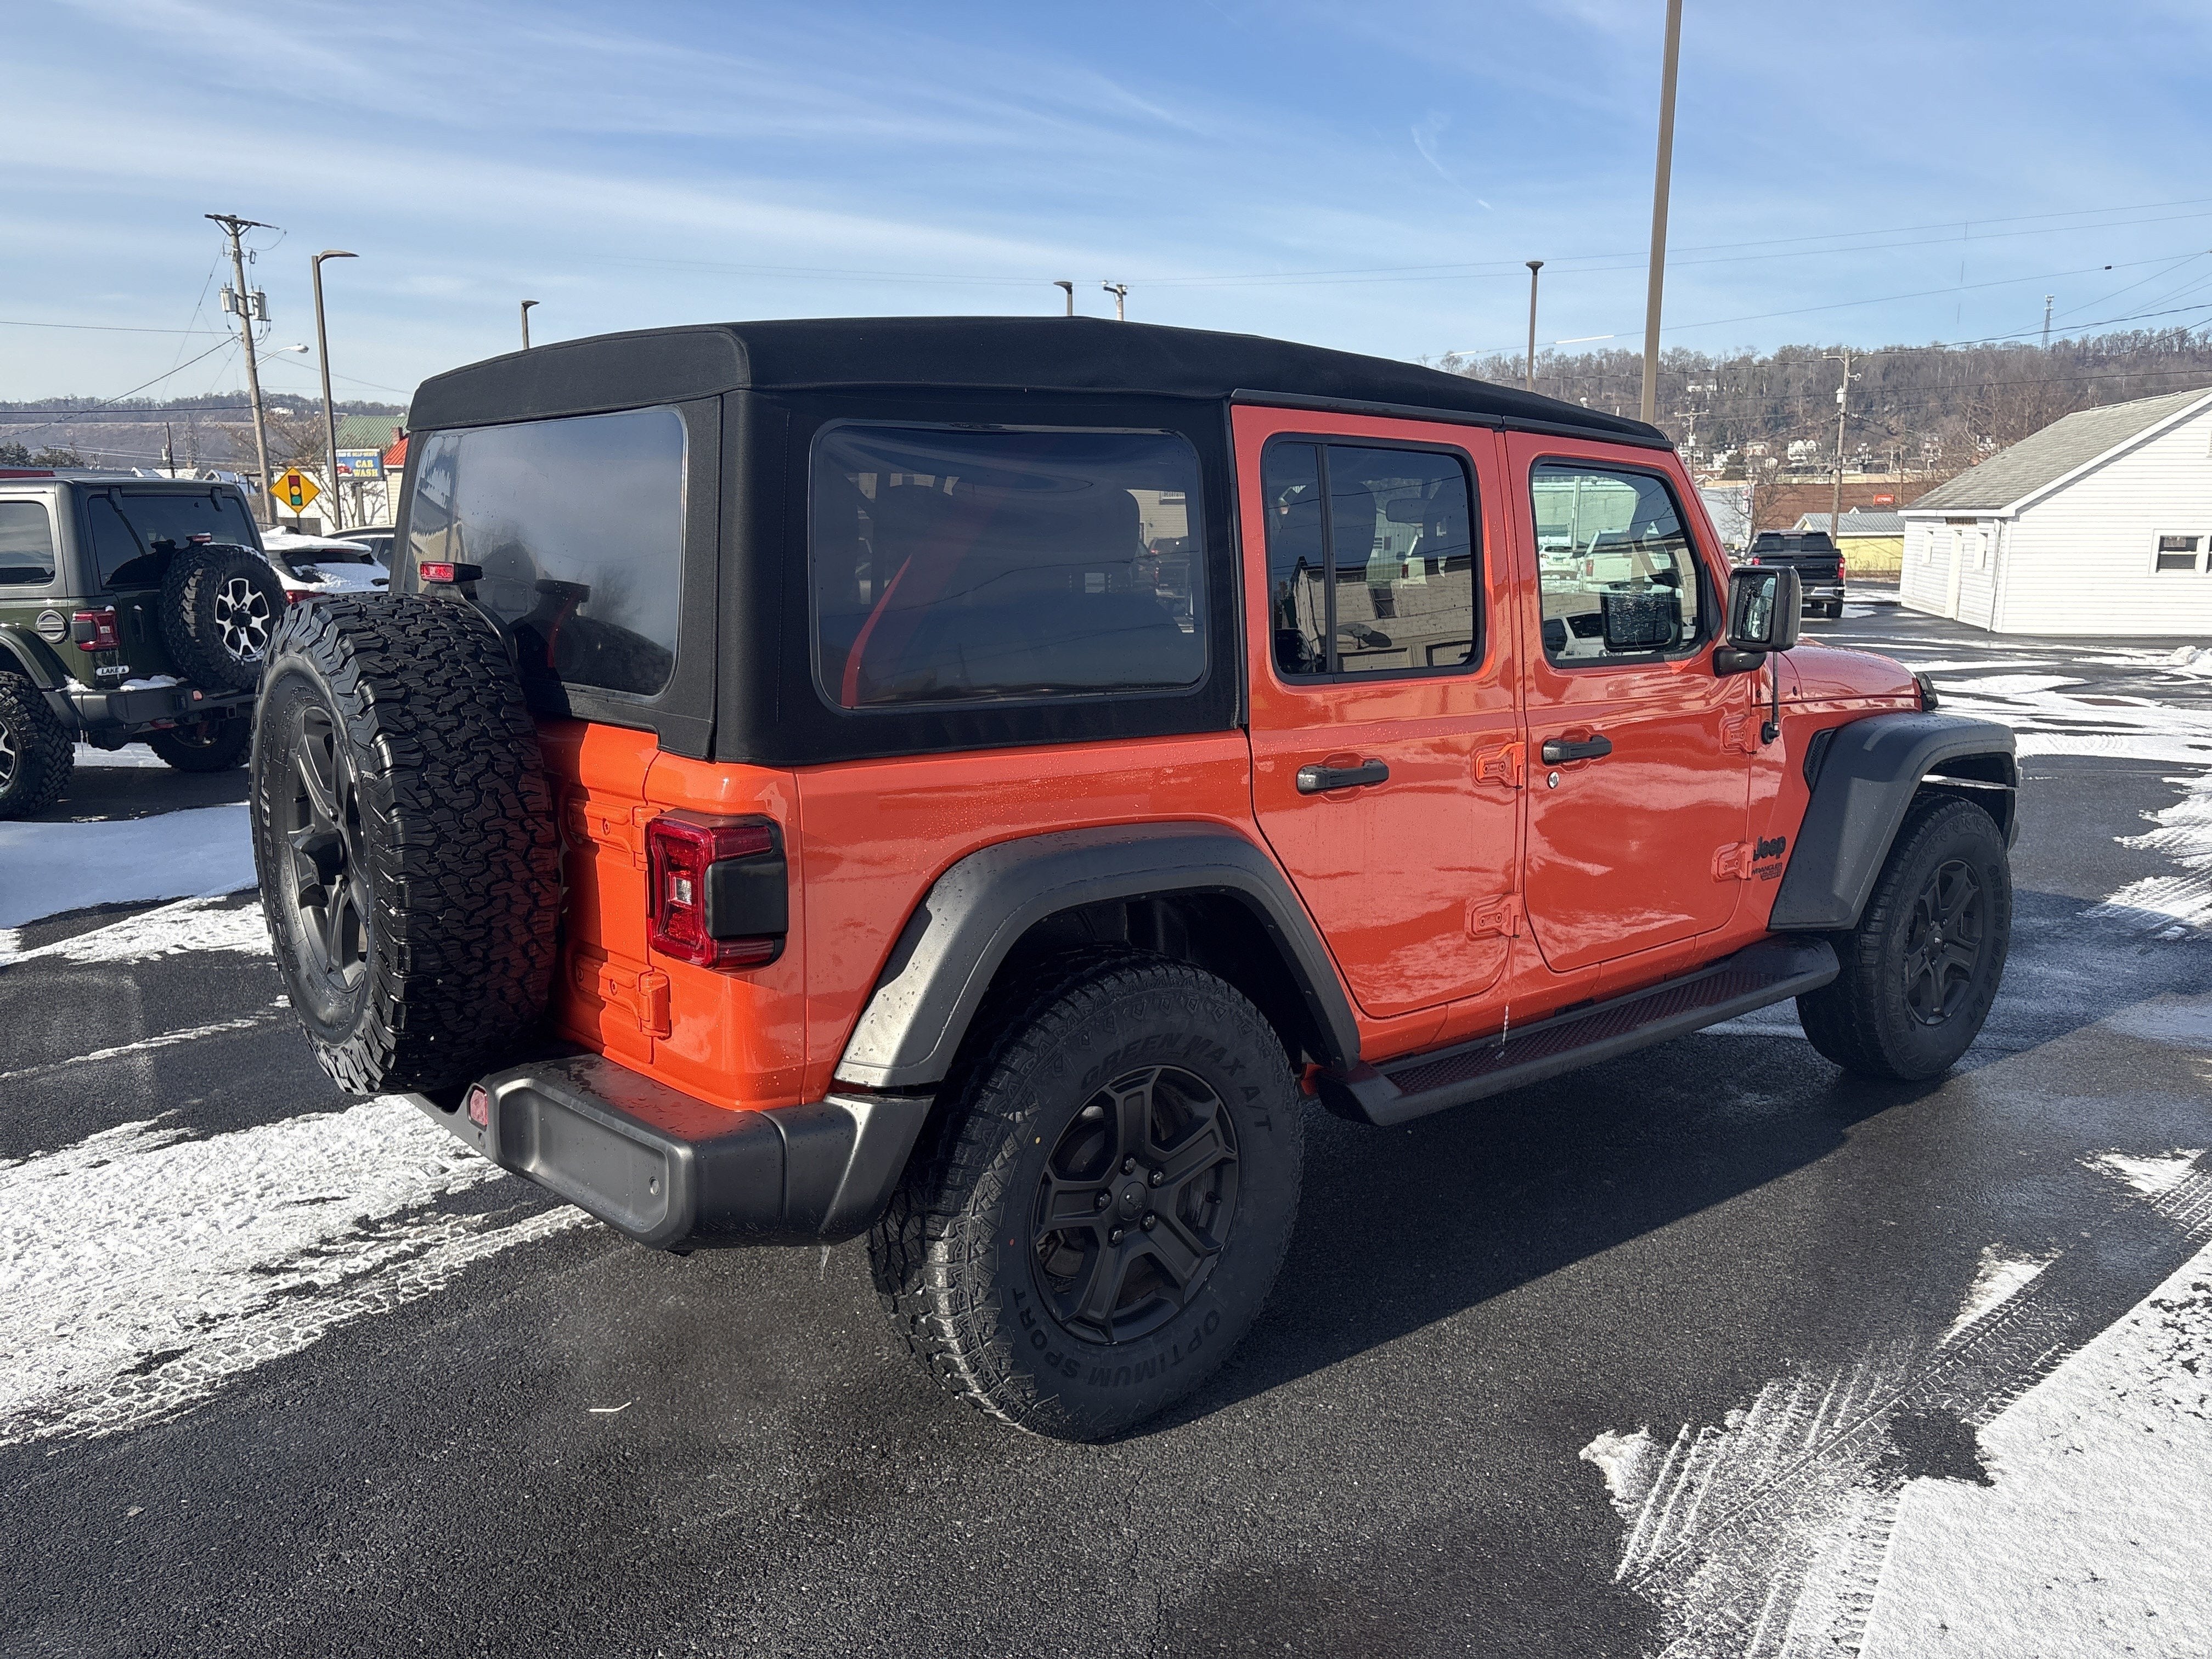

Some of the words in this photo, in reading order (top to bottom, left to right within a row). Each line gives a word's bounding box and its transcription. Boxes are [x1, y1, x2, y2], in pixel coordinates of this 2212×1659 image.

[353, 469, 379, 477] WASH
[355, 459, 374, 468] CAR
[1753, 836, 1786, 862] Jeep
[1080, 1031, 1183, 1091] GREEN
[1182, 1034, 1246, 1077] MAX
[1238, 1085, 1273, 1132] A/T
[1011, 1287, 1082, 1379] SPORT
[1087, 1309, 1220, 1387] OPTIMUM
